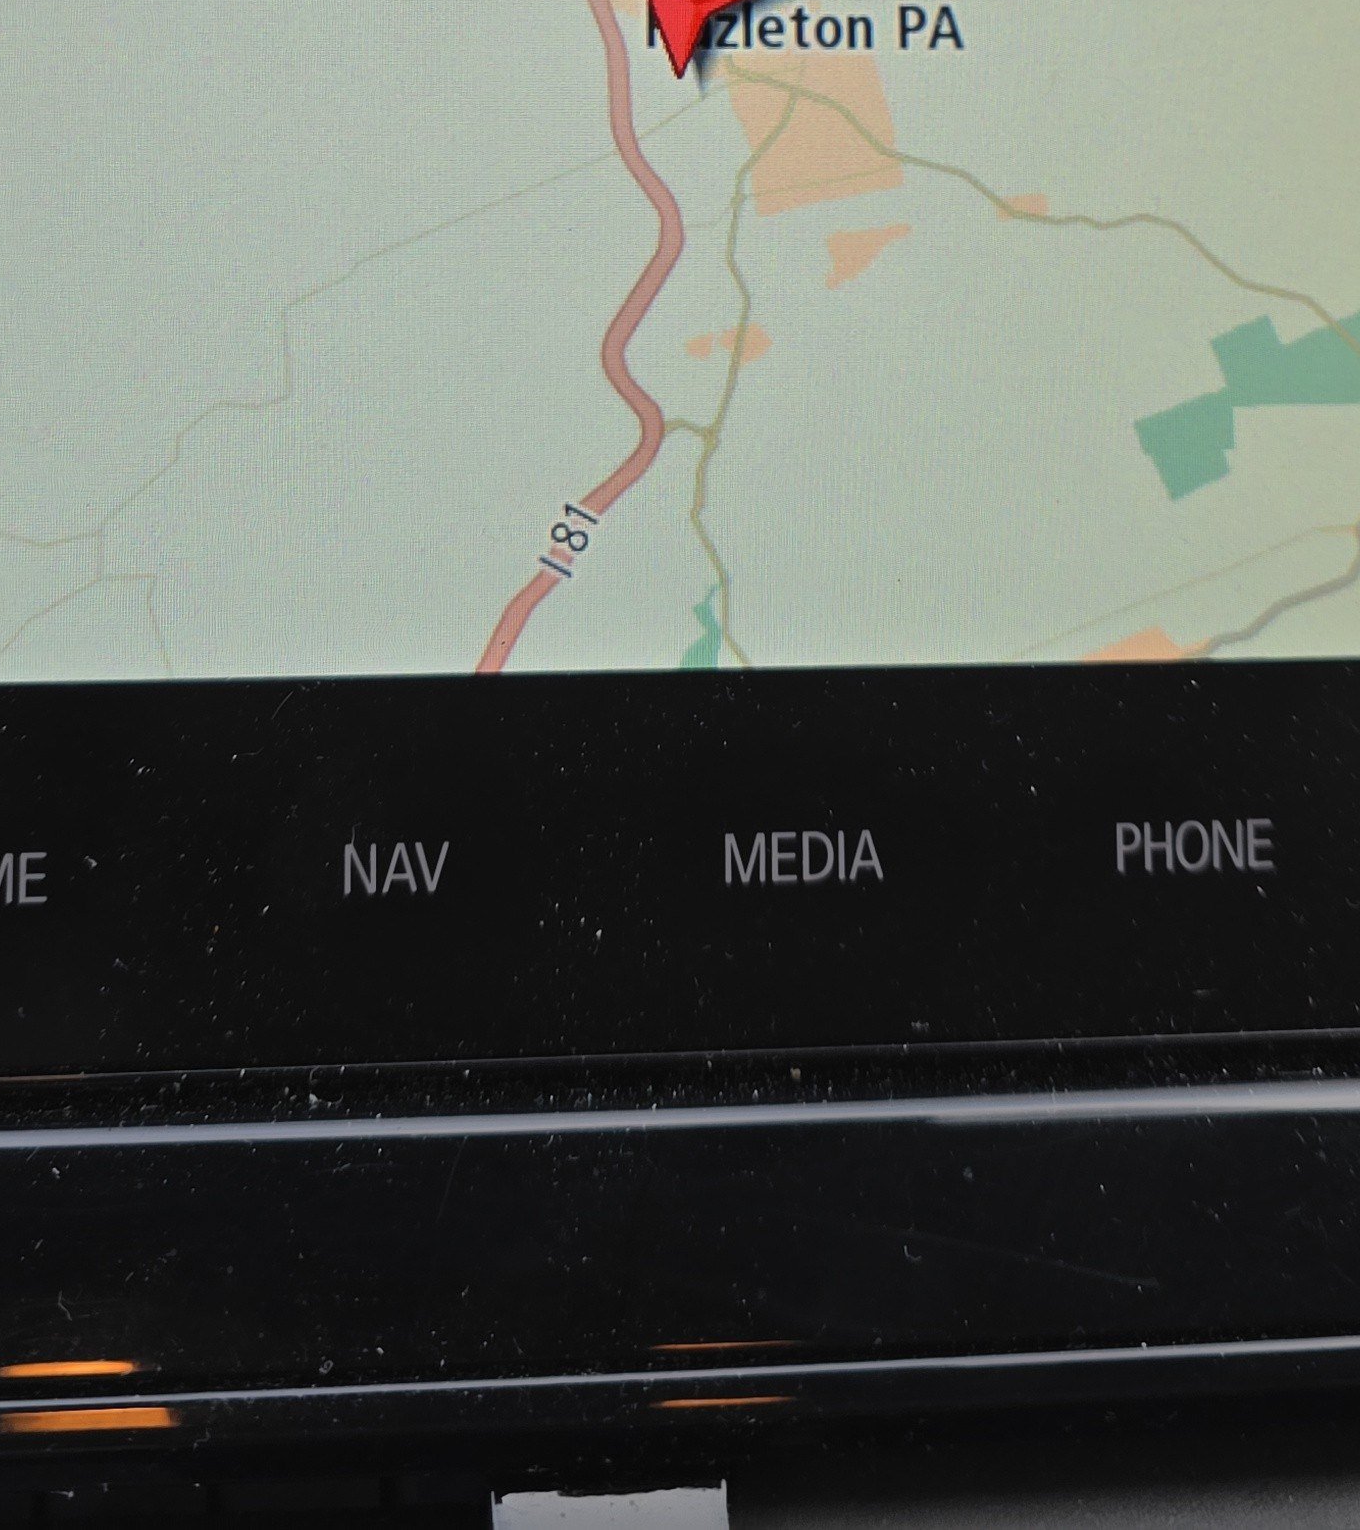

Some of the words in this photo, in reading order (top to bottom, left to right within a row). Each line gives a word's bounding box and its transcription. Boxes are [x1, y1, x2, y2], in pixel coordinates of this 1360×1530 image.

[898, 4, 965, 49] PA
[551, 503, 599, 552] 81
[343, 840, 450, 897] NAV
[724, 828, 885, 884] MEDIA
[1115, 817, 1276, 874] PHONE
